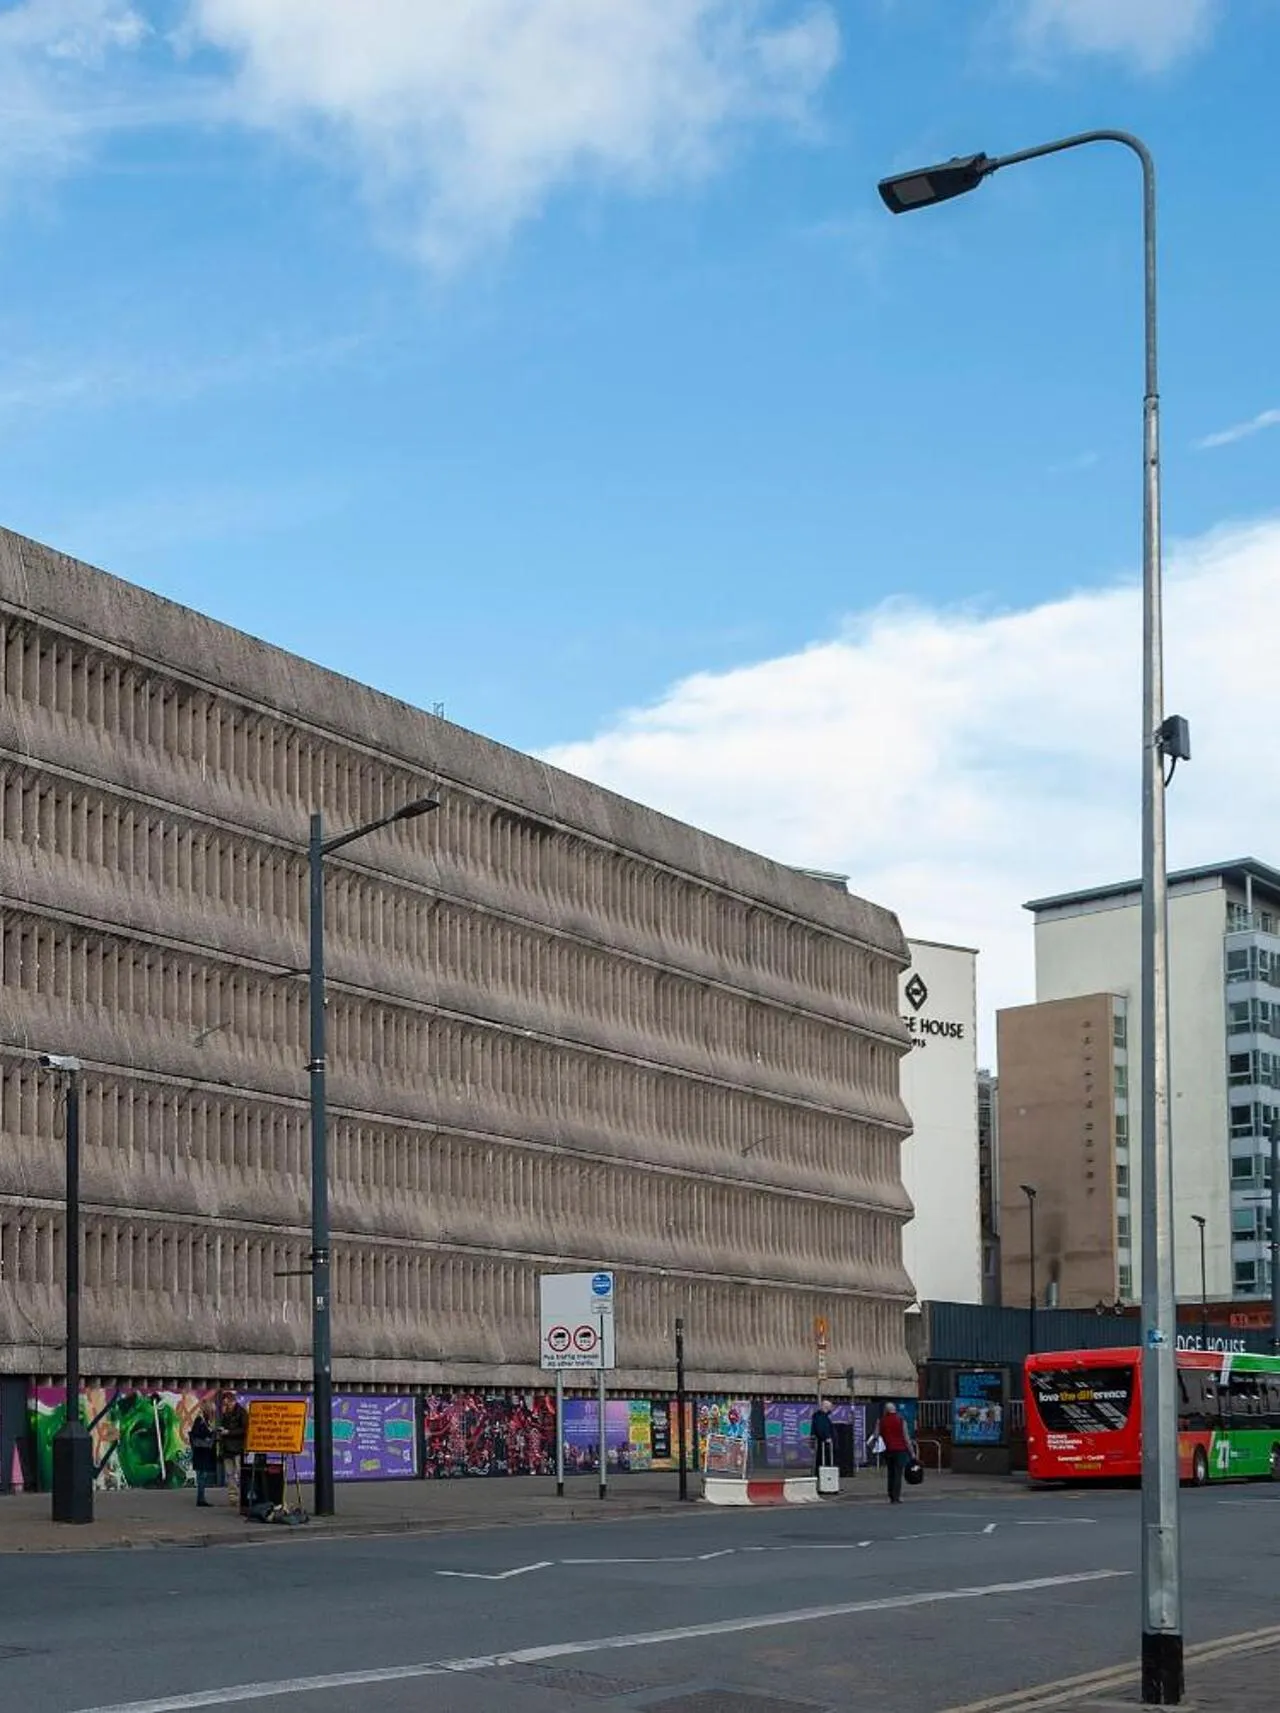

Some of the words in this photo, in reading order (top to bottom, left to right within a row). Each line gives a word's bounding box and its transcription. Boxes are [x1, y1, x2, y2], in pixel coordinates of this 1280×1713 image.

[920, 1018, 964, 1039] HOUSE
[1039, 1391, 1059, 1402] love
[1060, 1391, 1075, 1401] the
[1077, 1389, 1127, 1401] difference
